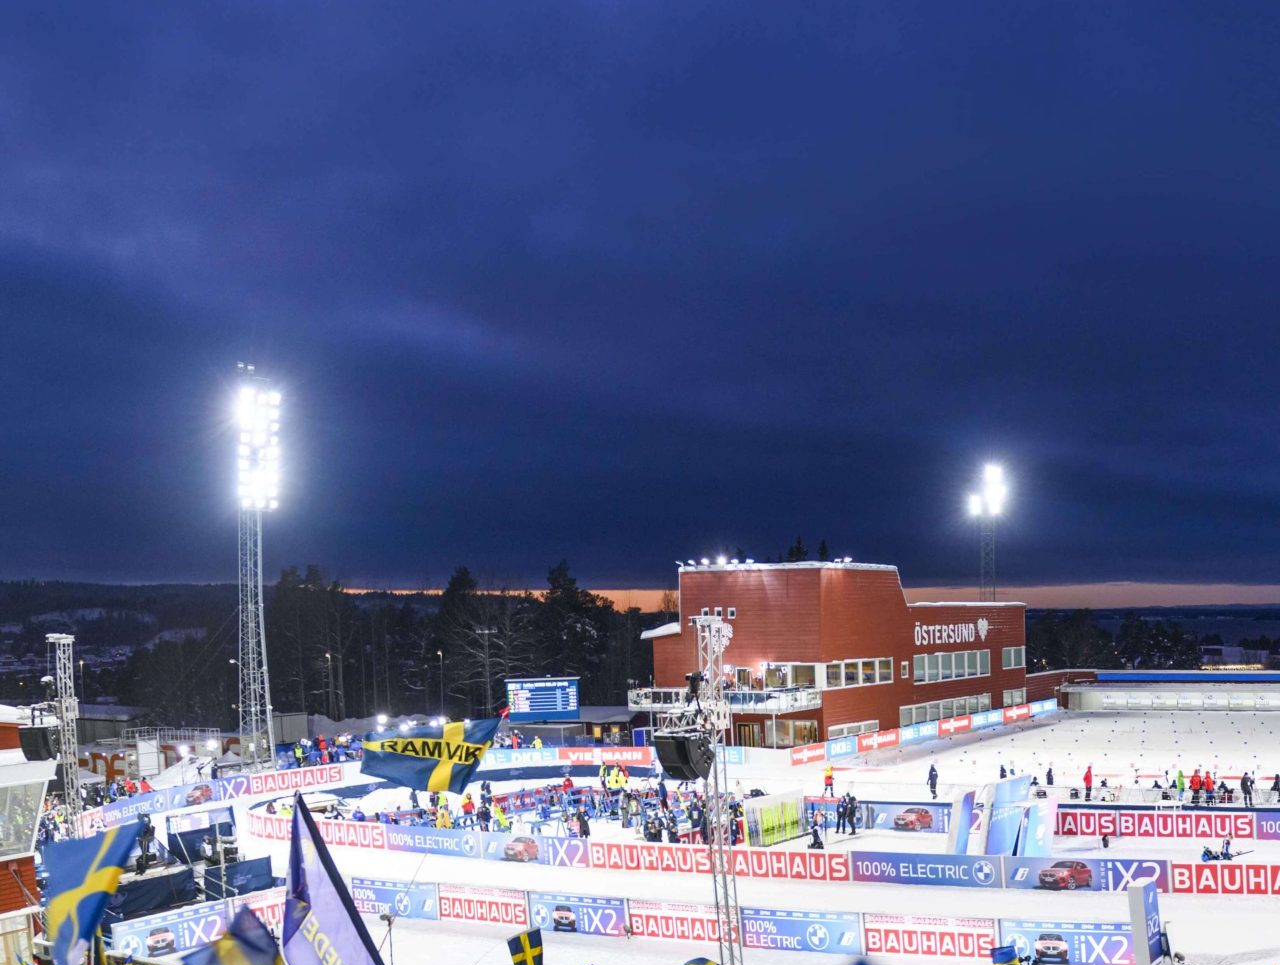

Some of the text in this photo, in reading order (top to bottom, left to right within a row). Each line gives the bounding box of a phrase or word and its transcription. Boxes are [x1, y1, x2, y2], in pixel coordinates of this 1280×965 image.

[914, 621, 975, 646] ÖSTERSUND
[381, 741, 485, 763] RAMVIK
[253, 767, 342, 793] BAUHAUS
[1120, 816, 1251, 836] BAUHAUS
[388, 832, 460, 851] 100% ELECTRIC
[551, 839, 585, 868] iX2
[592, 850, 711, 871] BAUHAUS
[856, 860, 969, 881] 100% ELECTRIC
[353, 887, 376, 901] 100%
[353, 900, 392, 915] ELECTRIC
[440, 897, 526, 924] BAUHAUS
[183, 915, 223, 948] iX2
[584, 907, 619, 934] iX2
[744, 919, 777, 934] 100%
[745, 933, 803, 949] ELECTRIC
[868, 930, 993, 956] BAUHAUS
[1080, 935, 1130, 964] iX2
